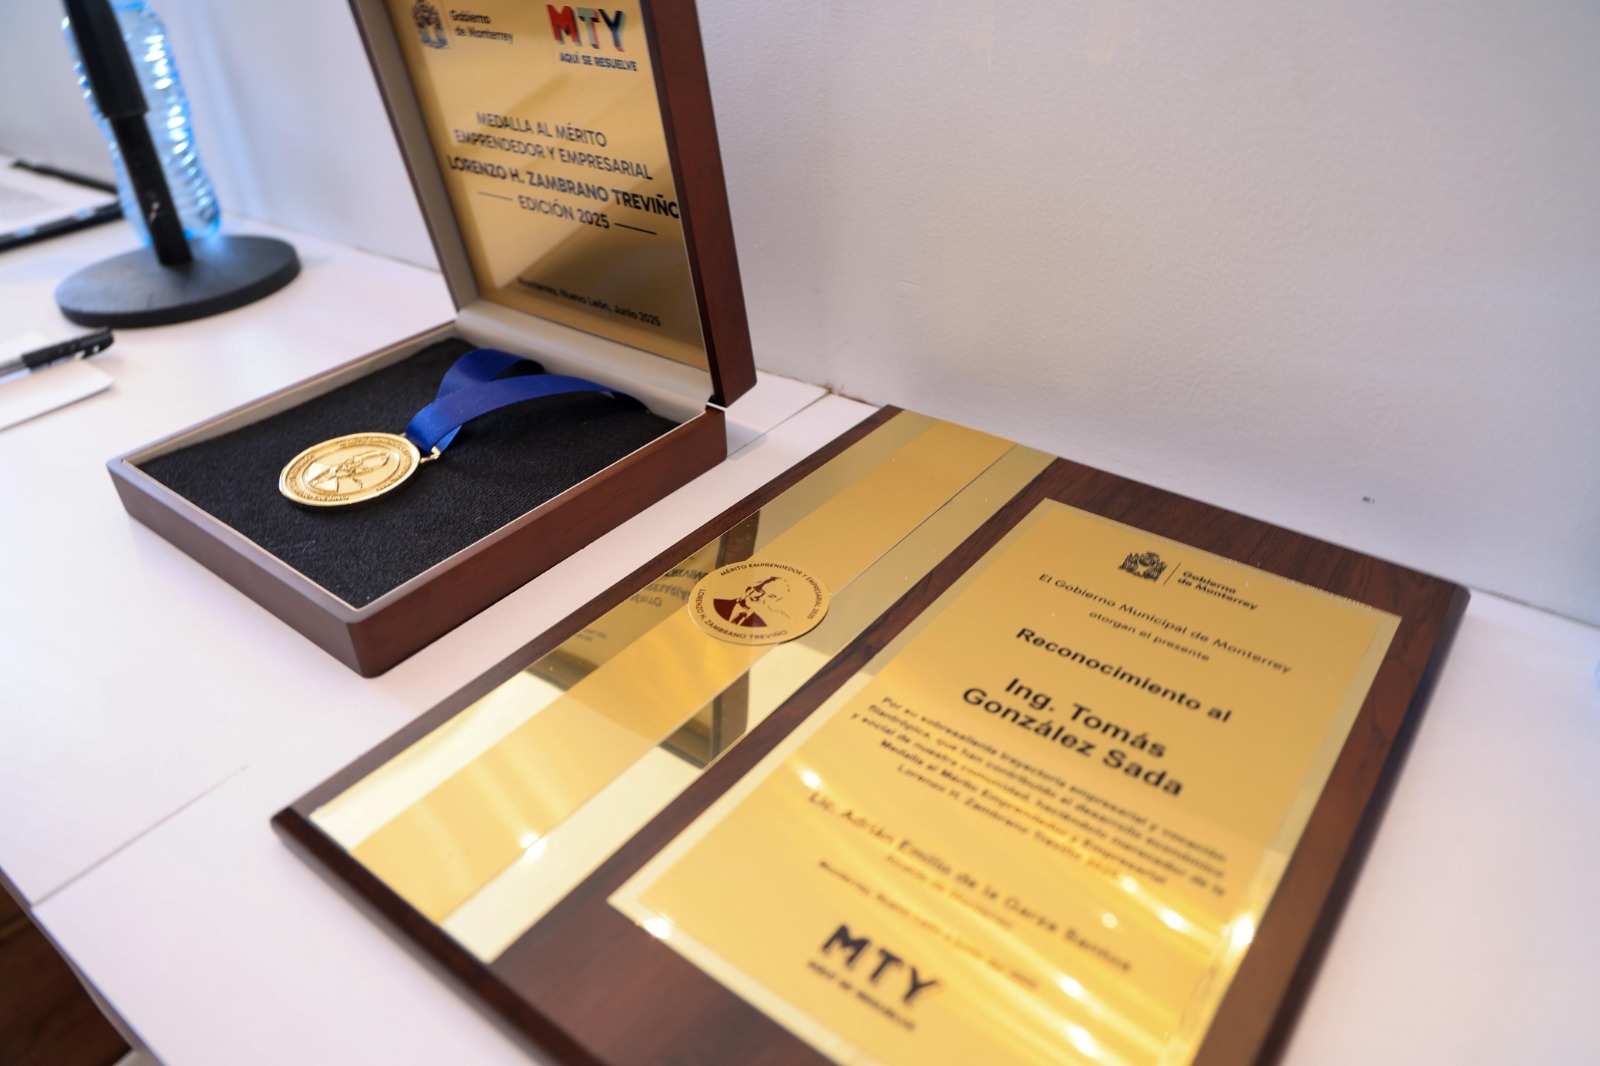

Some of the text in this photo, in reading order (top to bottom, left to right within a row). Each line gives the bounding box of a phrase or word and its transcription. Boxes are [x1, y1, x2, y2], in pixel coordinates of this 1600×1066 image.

[451, 9, 491, 25] Gobierno
[455, 27, 514, 44] de Monterrey
[546, 4, 627, 52] MTY
[559, 51, 639, 72] AQUÍ SE RESUELVE
[476, 112, 608, 148] MEDALLA AL MÉRITO
[447, 155, 507, 180] LORENZO
[508, 168, 525, 184] H.
[526, 171, 609, 203] ZAMBRANO
[454, 129, 653, 181] EMPRENDEDOR Y EMPRESARIAL
[518, 195, 610, 230] EDICIÓN 2025
[720, 563, 747, 577] MÉRITO
[748, 562, 803, 576] EMPRENDEDOR
[805, 576, 823, 608] EMPRESARIAL
[1177, 578, 1258, 611] de Monterrey
[1182, 570, 1236, 594] Gobierno
[695, 589, 706, 614] LORENZO
[704, 620, 747, 639] ZAMBRANO
[749, 629, 788, 639] TREVIÑO
[1038, 573, 1293, 674] El Gobierno Municipal de Monterrey
[1089, 611, 1210, 662] otorgan el presente
[1015, 626, 1233, 724] Reconocimiento al
[961, 687, 1184, 797] González Sada
[1004, 677, 1169, 760] Ing. Tomás
[822, 924, 939, 1006] MTY
